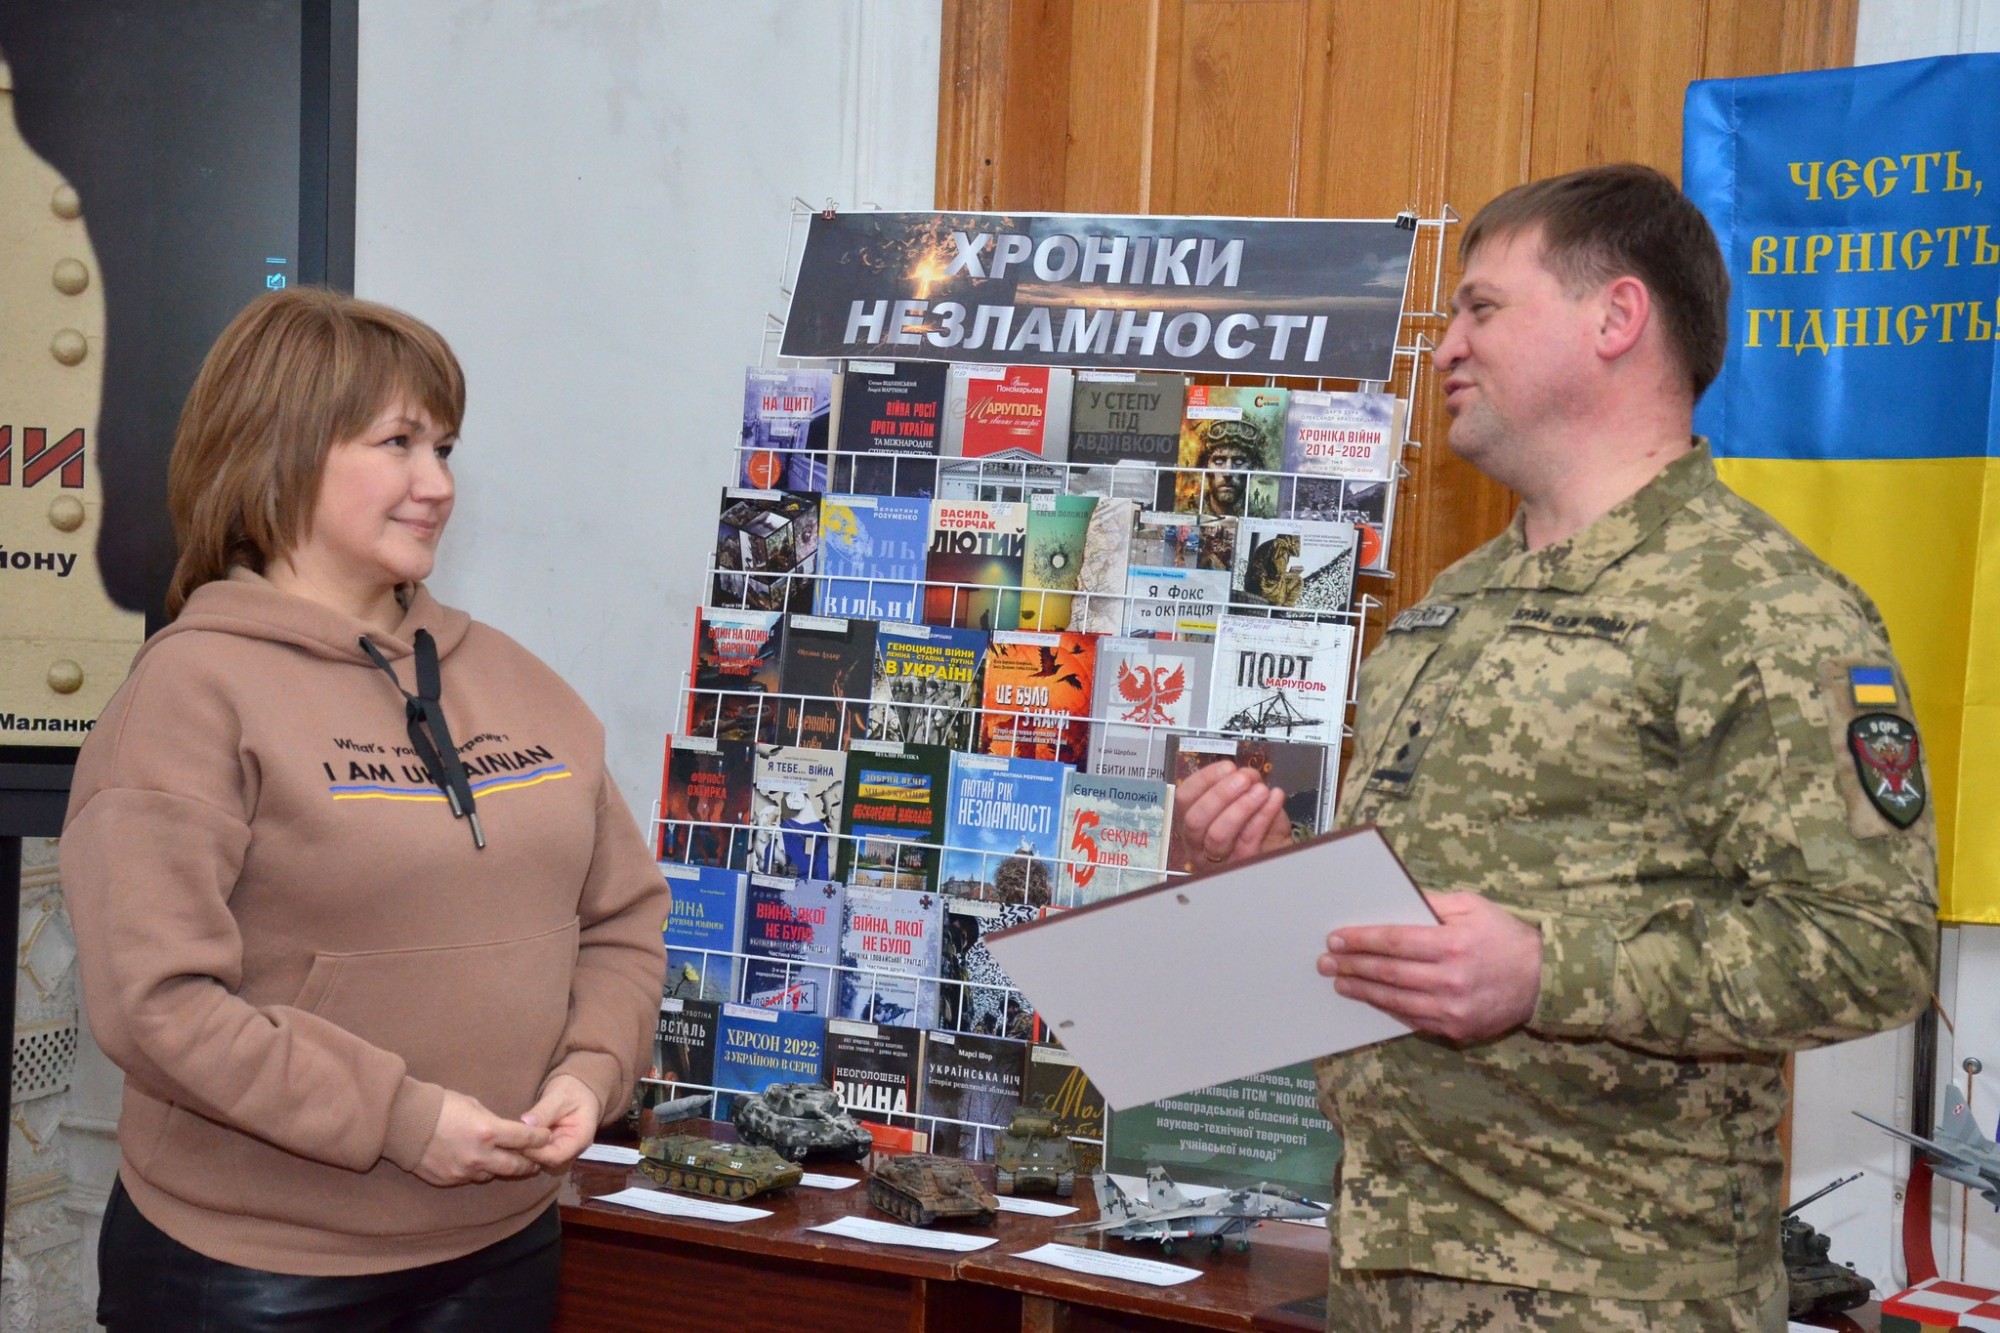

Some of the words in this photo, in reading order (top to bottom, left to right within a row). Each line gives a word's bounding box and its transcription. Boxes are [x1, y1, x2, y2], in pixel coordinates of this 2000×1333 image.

[948, 232, 1245, 287] ХРОНІКИ
[1747, 225, 2000, 275] ВІРНІСТЬ
[843, 300, 1329, 363] НЕЗЛАМНОСТІ
[996, 384, 1043, 395] Пономарьова
[763, 396, 778, 411] НА
[783, 396, 813, 413] ЩИТІ
[886, 400, 911, 416] ВІЙНА
[914, 402, 937, 418] РОСІЇ
[1090, 392, 1101, 409] У
[1105, 392, 1161, 411] СТЕПУ
[871, 420, 896, 435] ПРОТИ
[899, 421, 935, 438] УКРАЇНИ
[1108, 412, 1139, 433] ПІД
[874, 438, 882, 446] ТА
[883, 438, 933, 449] МІЖНАРОДНЕ
[1073, 434, 1173, 455] АВДІЇВКОЮ
[1299, 429, 1345, 442] ХРОНІКА
[1348, 430, 1381, 444] ВІЙНИ
[873, 512, 918, 521] РОЗУМЕНКО
[940, 509, 989, 520] ВАСИЛЬ
[940, 519, 996, 530] СТОРЧАК
[930, 527, 1026, 557] ЛЮТИЙ
[1149, 585, 1158, 598] Я
[825, 596, 914, 619] ВІЛЬНІ
[1141, 609, 1151, 617] та
[1155, 604, 1214, 618] ОКУПАЦІЯ
[708, 627, 730, 640] ОДИН
[732, 628, 743, 640] НА
[745, 629, 769, 642] ОДИН
[886, 651, 910, 659] ЛЕНІНА
[887, 642, 942, 656] ГЕНОЦИДНІ
[945, 648, 975, 659] ВІЙНИ
[885, 660, 897, 674] В
[903, 661, 973, 683] УКРАЇНІ
[1238, 651, 1313, 692] ПОРТ
[1266, 677, 1327, 692] МАРІУПОЛЬ
[996, 685, 1012, 704] ЦЕ
[1016, 686, 1049, 707] БУЛО
[0, 713, 97, 732] Маланю
[1033, 709, 1070, 730] НАМИ
[334, 737, 386, 754] What's
[392, 746, 418, 758] you
[323, 762, 336, 782] I
[350, 761, 396, 783] AM
[402, 745, 554, 784] UKAINIAN
[768, 762, 774, 771] Я
[777, 762, 806, 774] ТЕБЕ...
[808, 764, 834, 777] ВІЙНА
[993, 771, 1023, 779] ВАЛЕНТИНА
[688, 784, 727, 799] ОХТИРКА
[961, 778, 995, 800] ЛЮТИЙ
[997, 782, 1013, 801] РІК
[1073, 784, 1106, 799] Євген
[1109, 787, 1158, 803] Положій
[958, 798, 1052, 834] НЕЗЛАМНОСТІ
[1100, 828, 1148, 848] секунд
[1098, 850, 1129, 866] днів
[670, 899, 704, 918] ІЙНА
[765, 923, 780, 939] НЕ
[782, 925, 815, 942] БУЛО
[895, 919, 924, 937] ЯКОЇ
[863, 936, 877, 951] НЕ
[880, 937, 911, 955] БУЛО
[655, 1019, 706, 1038] ВСТАЛЬ
[726, 1028, 780, 1052] ХЕРСОН
[784, 1037, 820, 1057] 2022:
[724, 1050, 730, 1061] З
[731, 1051, 779, 1069] УКРАЇНОЮ
[781, 1059, 788, 1070] В
[789, 1060, 817, 1075] СЕРЦІ
[958, 1049, 978, 1059] Марсі
[978, 1052, 993, 1062] Шор
[836, 1067, 906, 1084] НЕОГОЛОШЕНА
[929, 1063, 998, 1082] УКРАЇНСЬКА
[1003, 1073, 1020, 1086] НІЧ
[1240, 1072, 1294, 1089] лкачова,
[1296, 1080, 1318, 1093] кер
[928, 1076, 952, 1087] Історія
[953, 1081, 987, 1093] революції
[834, 1080, 907, 1113] ВІЙНА
[1155, 1099, 1245, 1119] Кіровоградський
[1247, 1109, 1298, 1126] обласний
[1301, 1117, 1333, 1131] центр
[1157, 1117, 1254, 1139] науково-технічної
[1256, 1128, 1307, 1146] творчості
[1180, 1138, 1236, 1156] учнівської
[730, 1161, 743, 1169] 327
